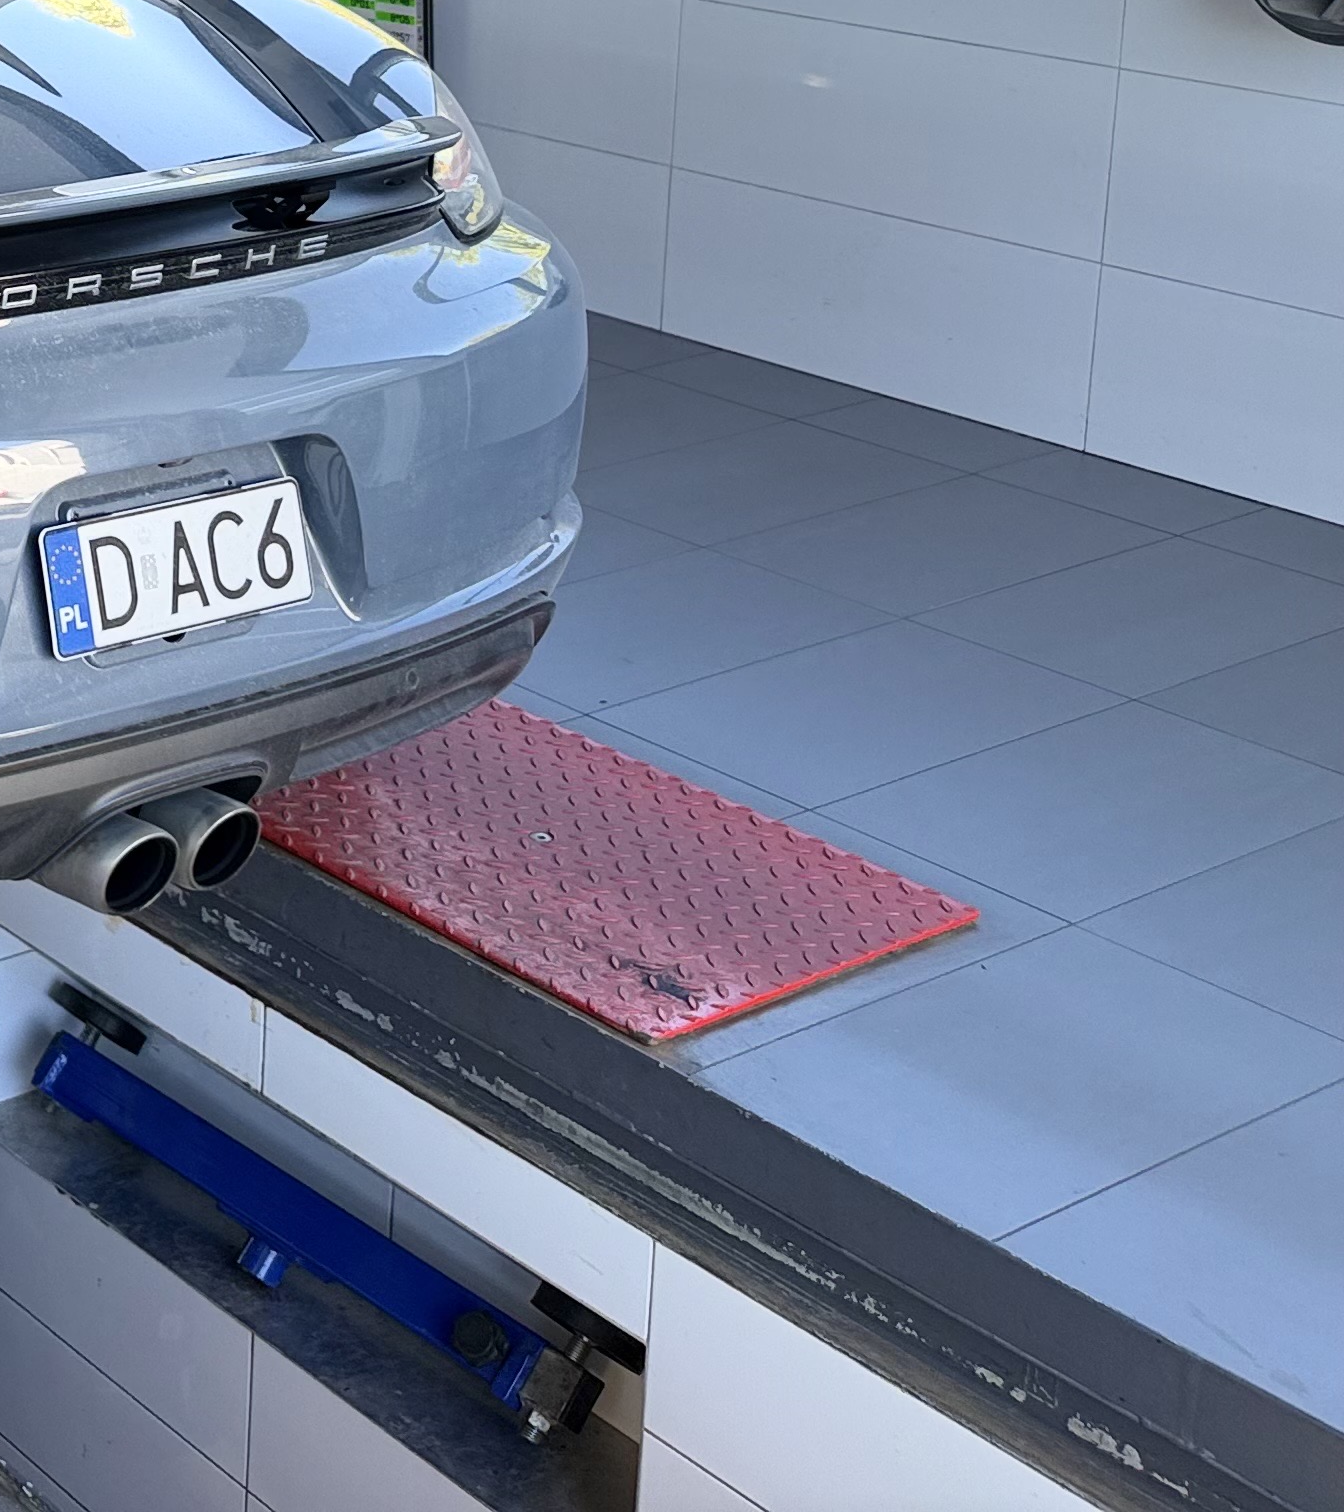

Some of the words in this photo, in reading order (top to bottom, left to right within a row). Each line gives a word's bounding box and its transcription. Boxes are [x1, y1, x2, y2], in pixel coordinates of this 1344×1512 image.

[89, 536, 139, 631] D
[170, 497, 294, 616] AC6
[58, 604, 89, 634] PL
